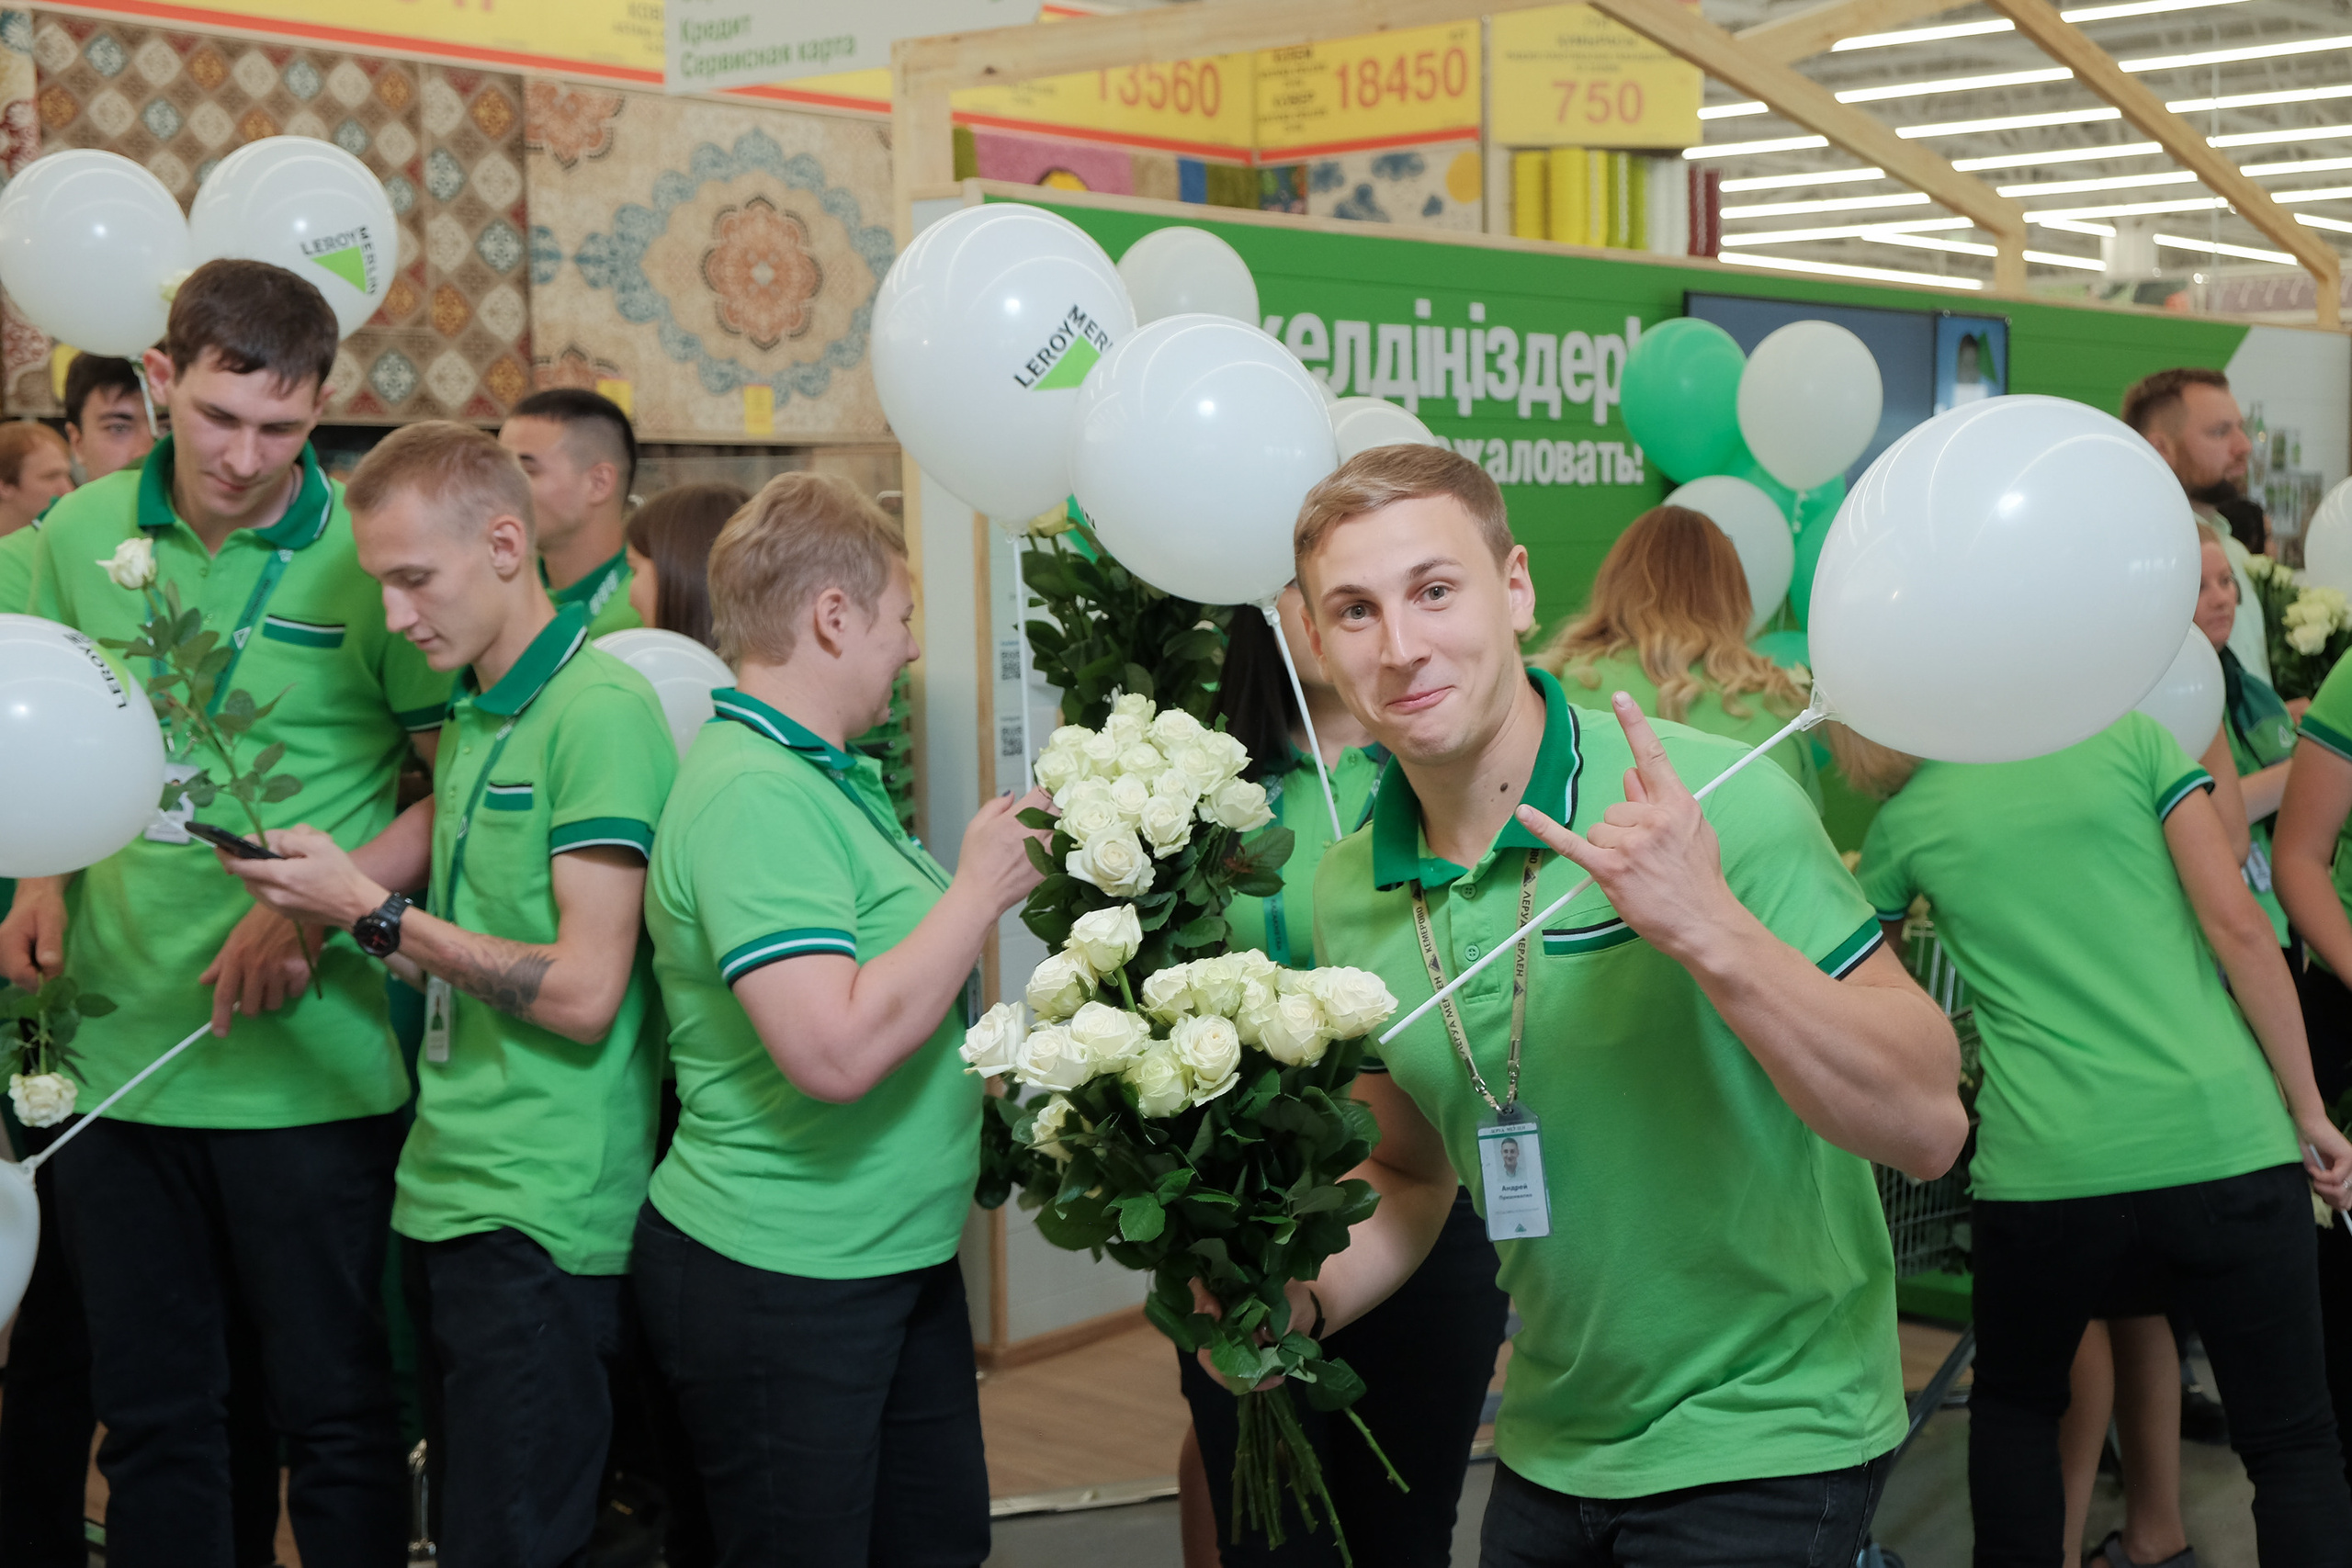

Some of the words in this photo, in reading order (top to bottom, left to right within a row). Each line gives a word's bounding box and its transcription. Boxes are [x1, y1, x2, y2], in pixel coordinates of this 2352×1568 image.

[679, 13, 752, 48] Кредит
[680, 44, 791, 79] Сервисная
[796, 33, 856, 64] карта
[1335, 46, 1468, 110] 18450
[1097, 59, 1220, 118] 13560
[1552, 79, 1645, 124] 750
[300, 230, 358, 255] LEROY
[1012, 319, 1075, 389] LEROY
[1067, 302, 1114, 352] MER
[1434, 434, 1645, 486] жаловать!
[1434, 976, 1454, 1018] МЕРЕН
[1501, 1182, 1528, 1192] Андрей
